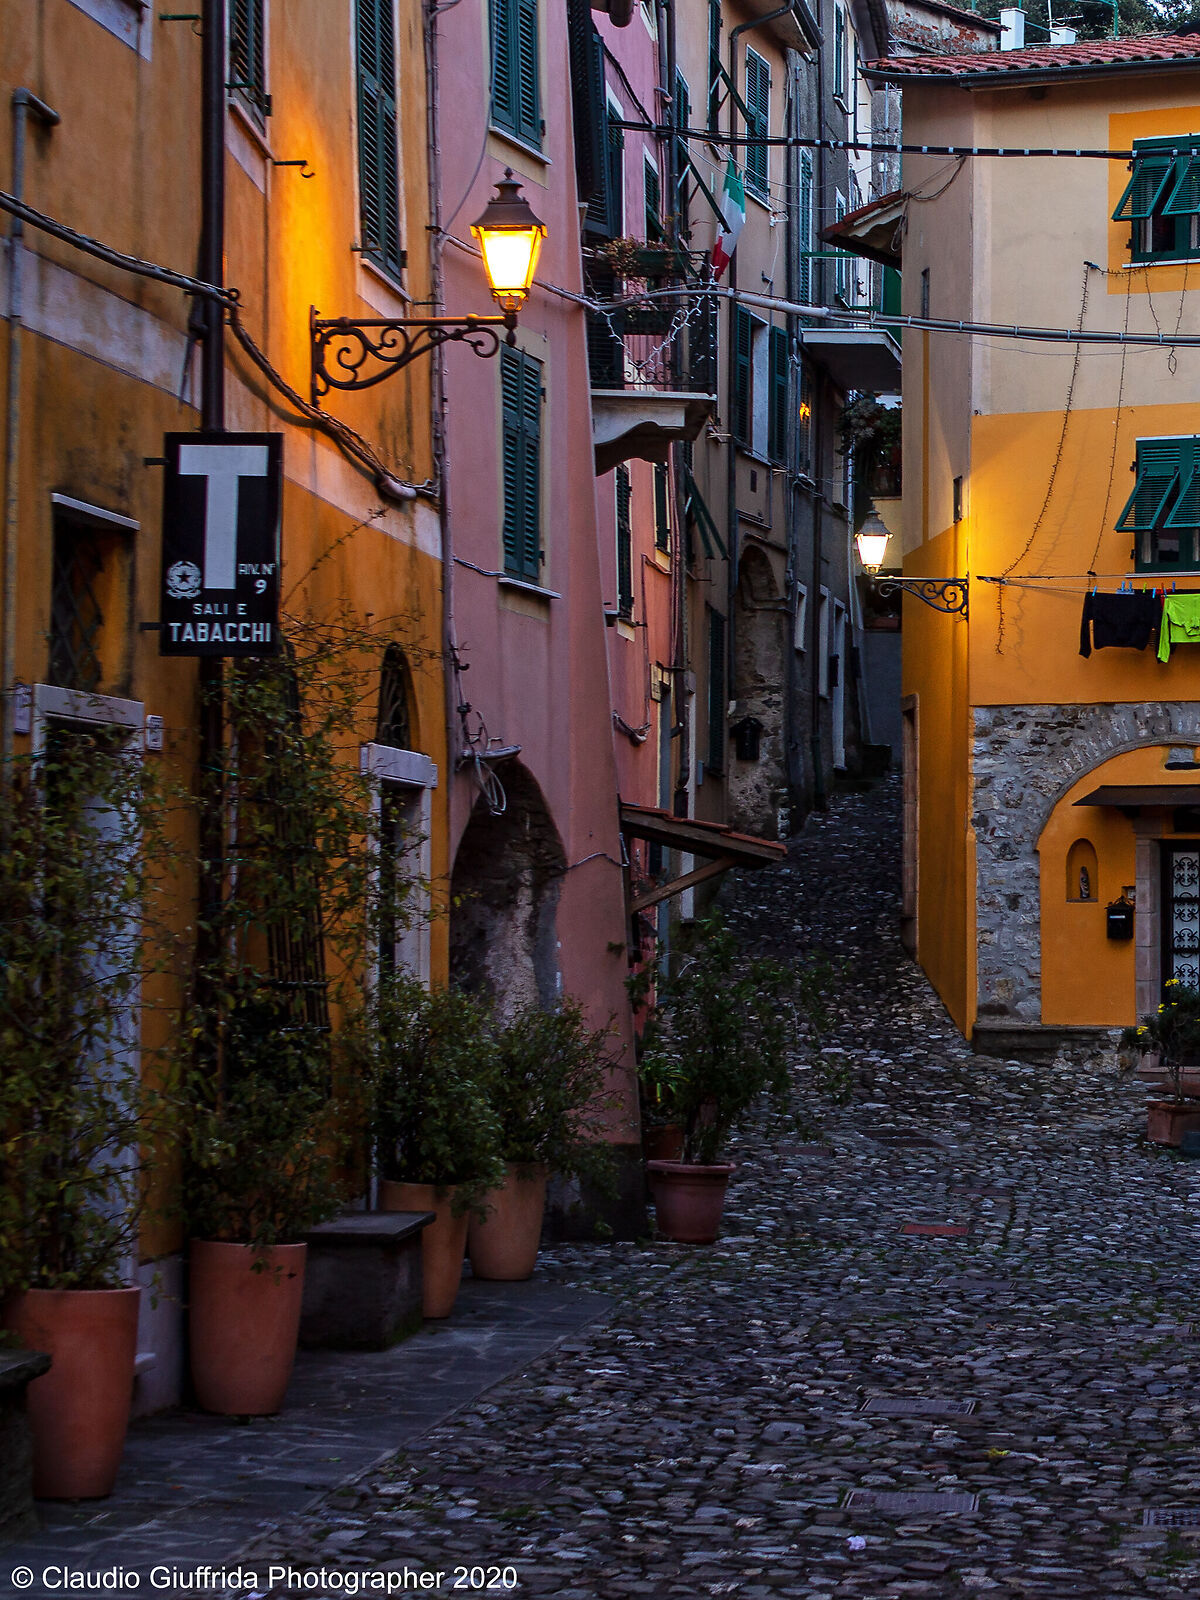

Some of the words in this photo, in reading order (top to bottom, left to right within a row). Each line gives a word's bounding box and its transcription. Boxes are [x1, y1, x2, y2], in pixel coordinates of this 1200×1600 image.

[178, 444, 269, 589] T
[254, 579, 267, 594] 9
[193, 603, 229, 615] SALI
[236, 603, 247, 615] E
[169, 622, 271, 642] TABACCHI
